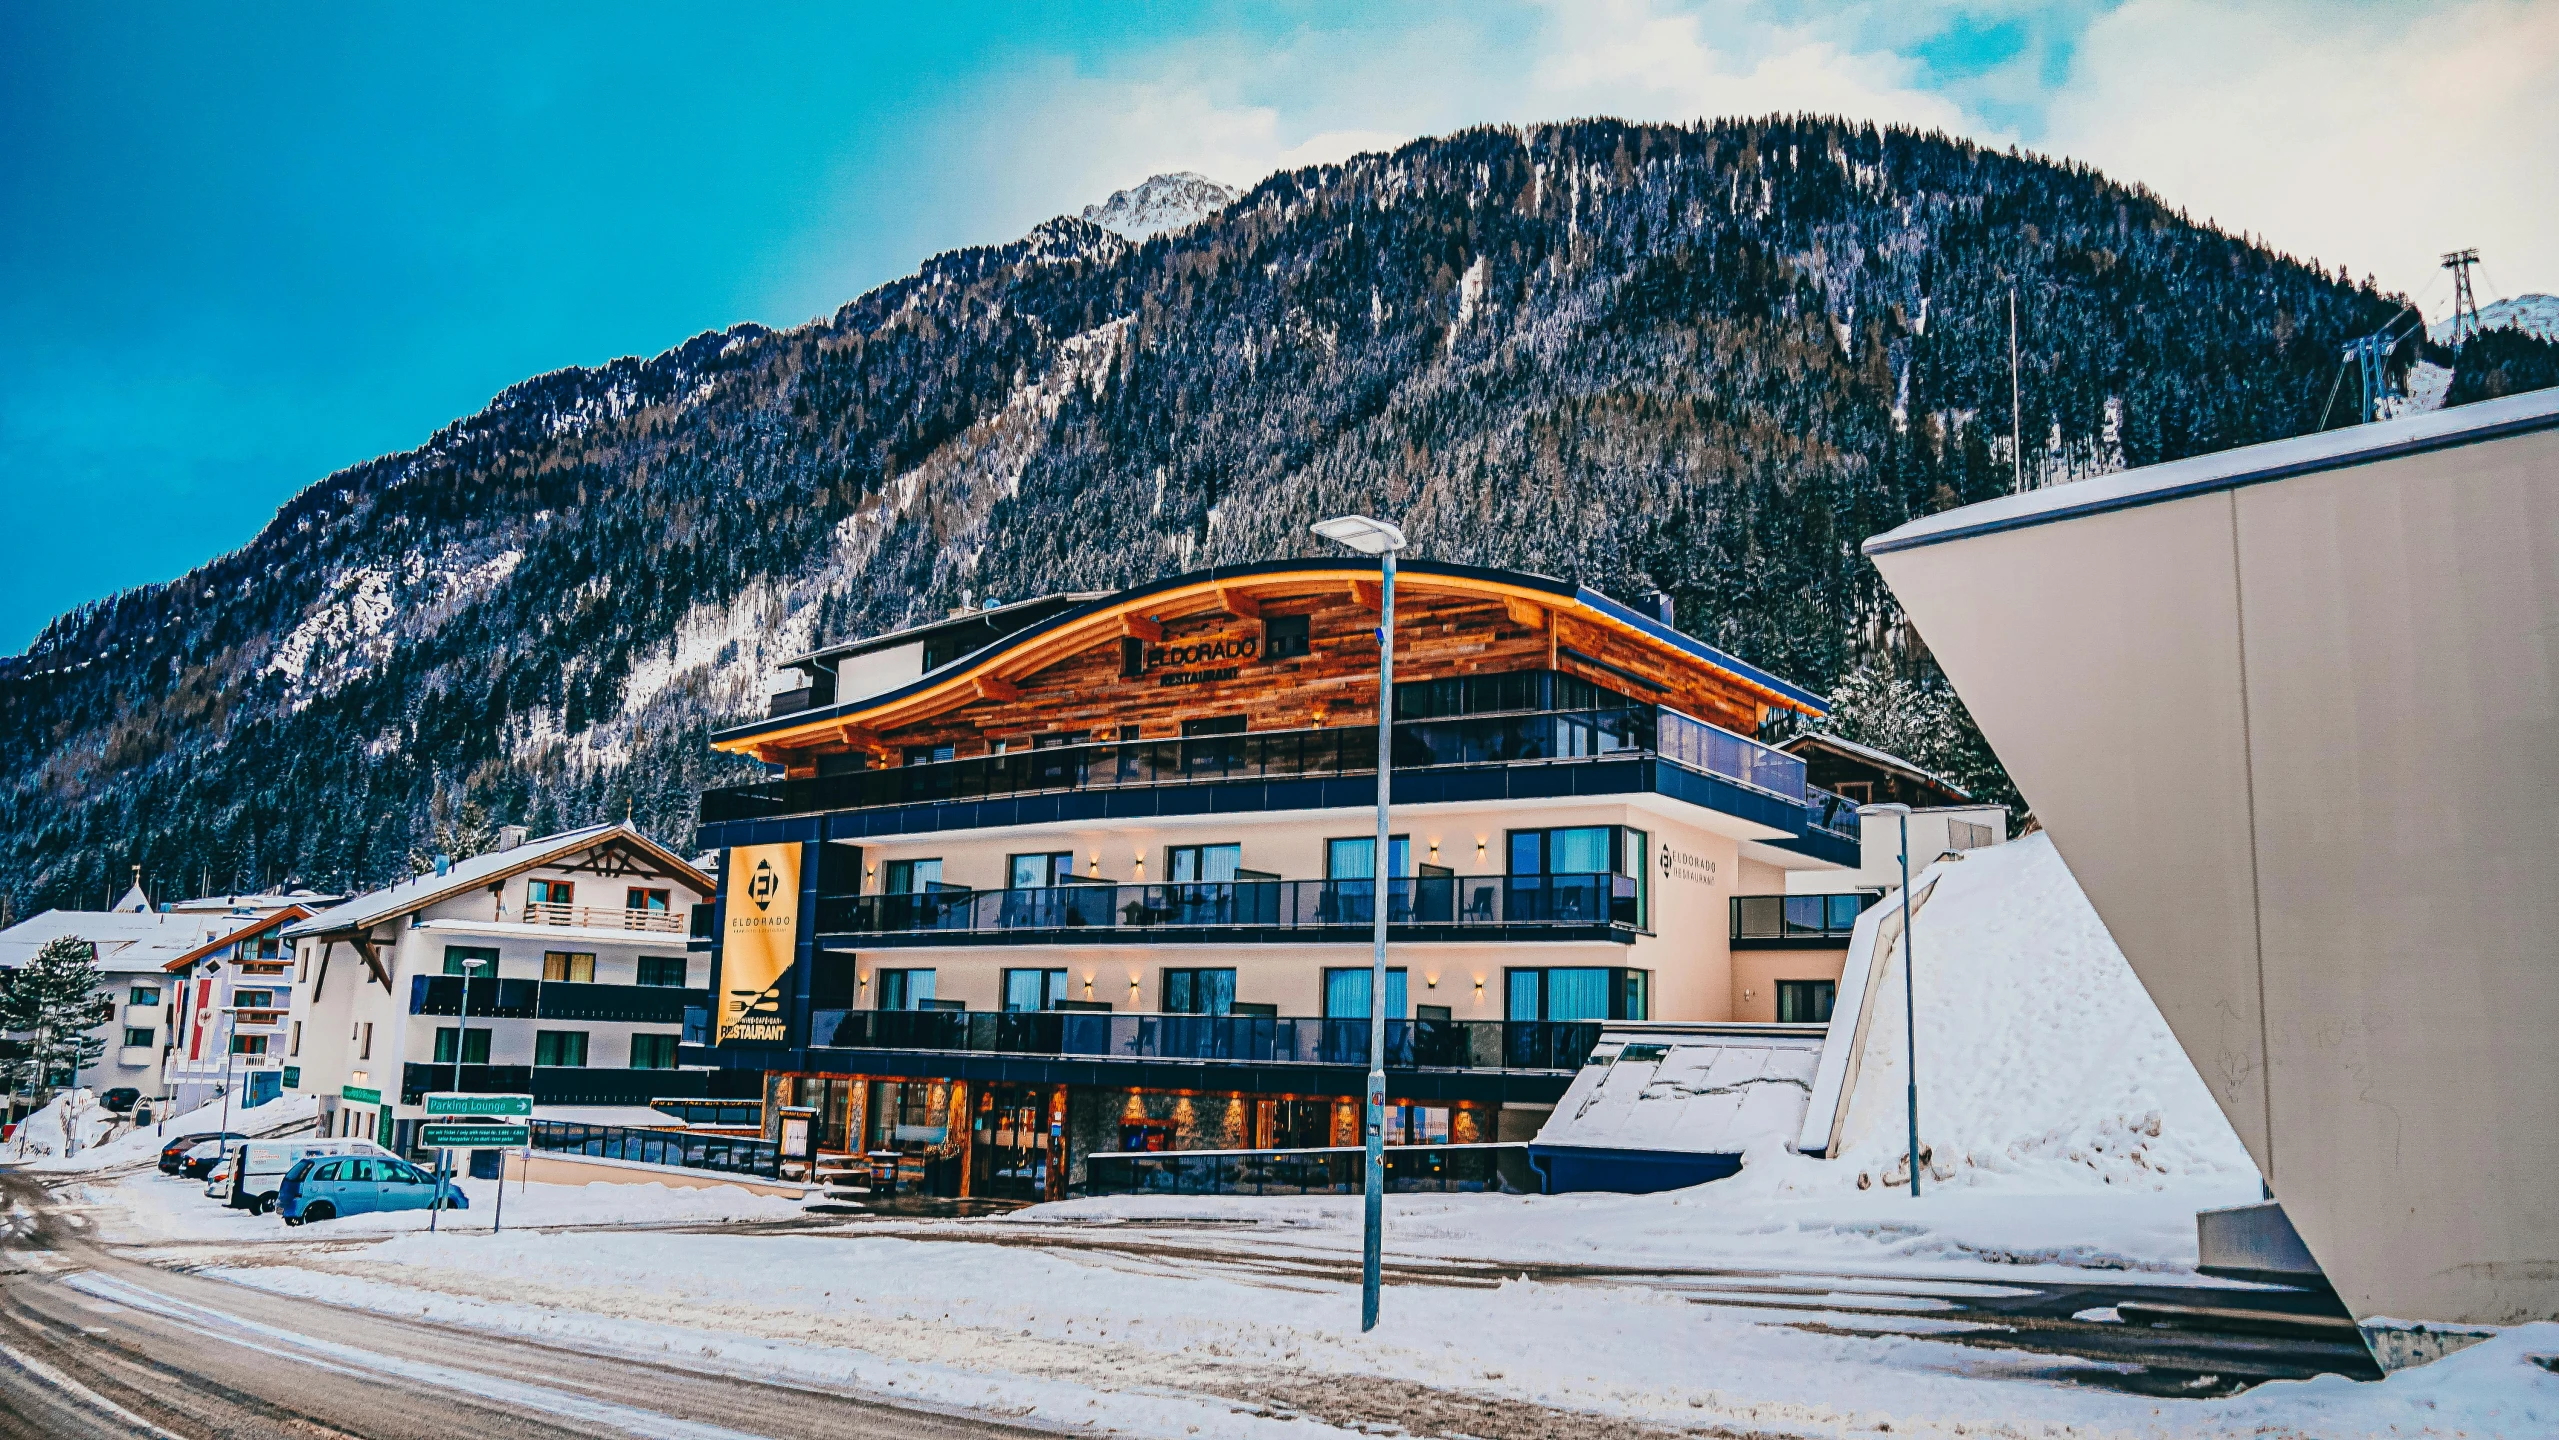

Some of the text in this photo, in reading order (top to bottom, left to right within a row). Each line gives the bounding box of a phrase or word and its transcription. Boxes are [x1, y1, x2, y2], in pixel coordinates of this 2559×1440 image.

[1147, 637, 1257, 668] ELDORADO
[1160, 666, 1239, 687] RESTAURANT
[1672, 849, 1716, 874] ELDORADO
[732, 916, 790, 927] ELDORADO
[721, 1024, 786, 1041] RESTAURANT
[430, 1100, 506, 1112] Parking Lounge
